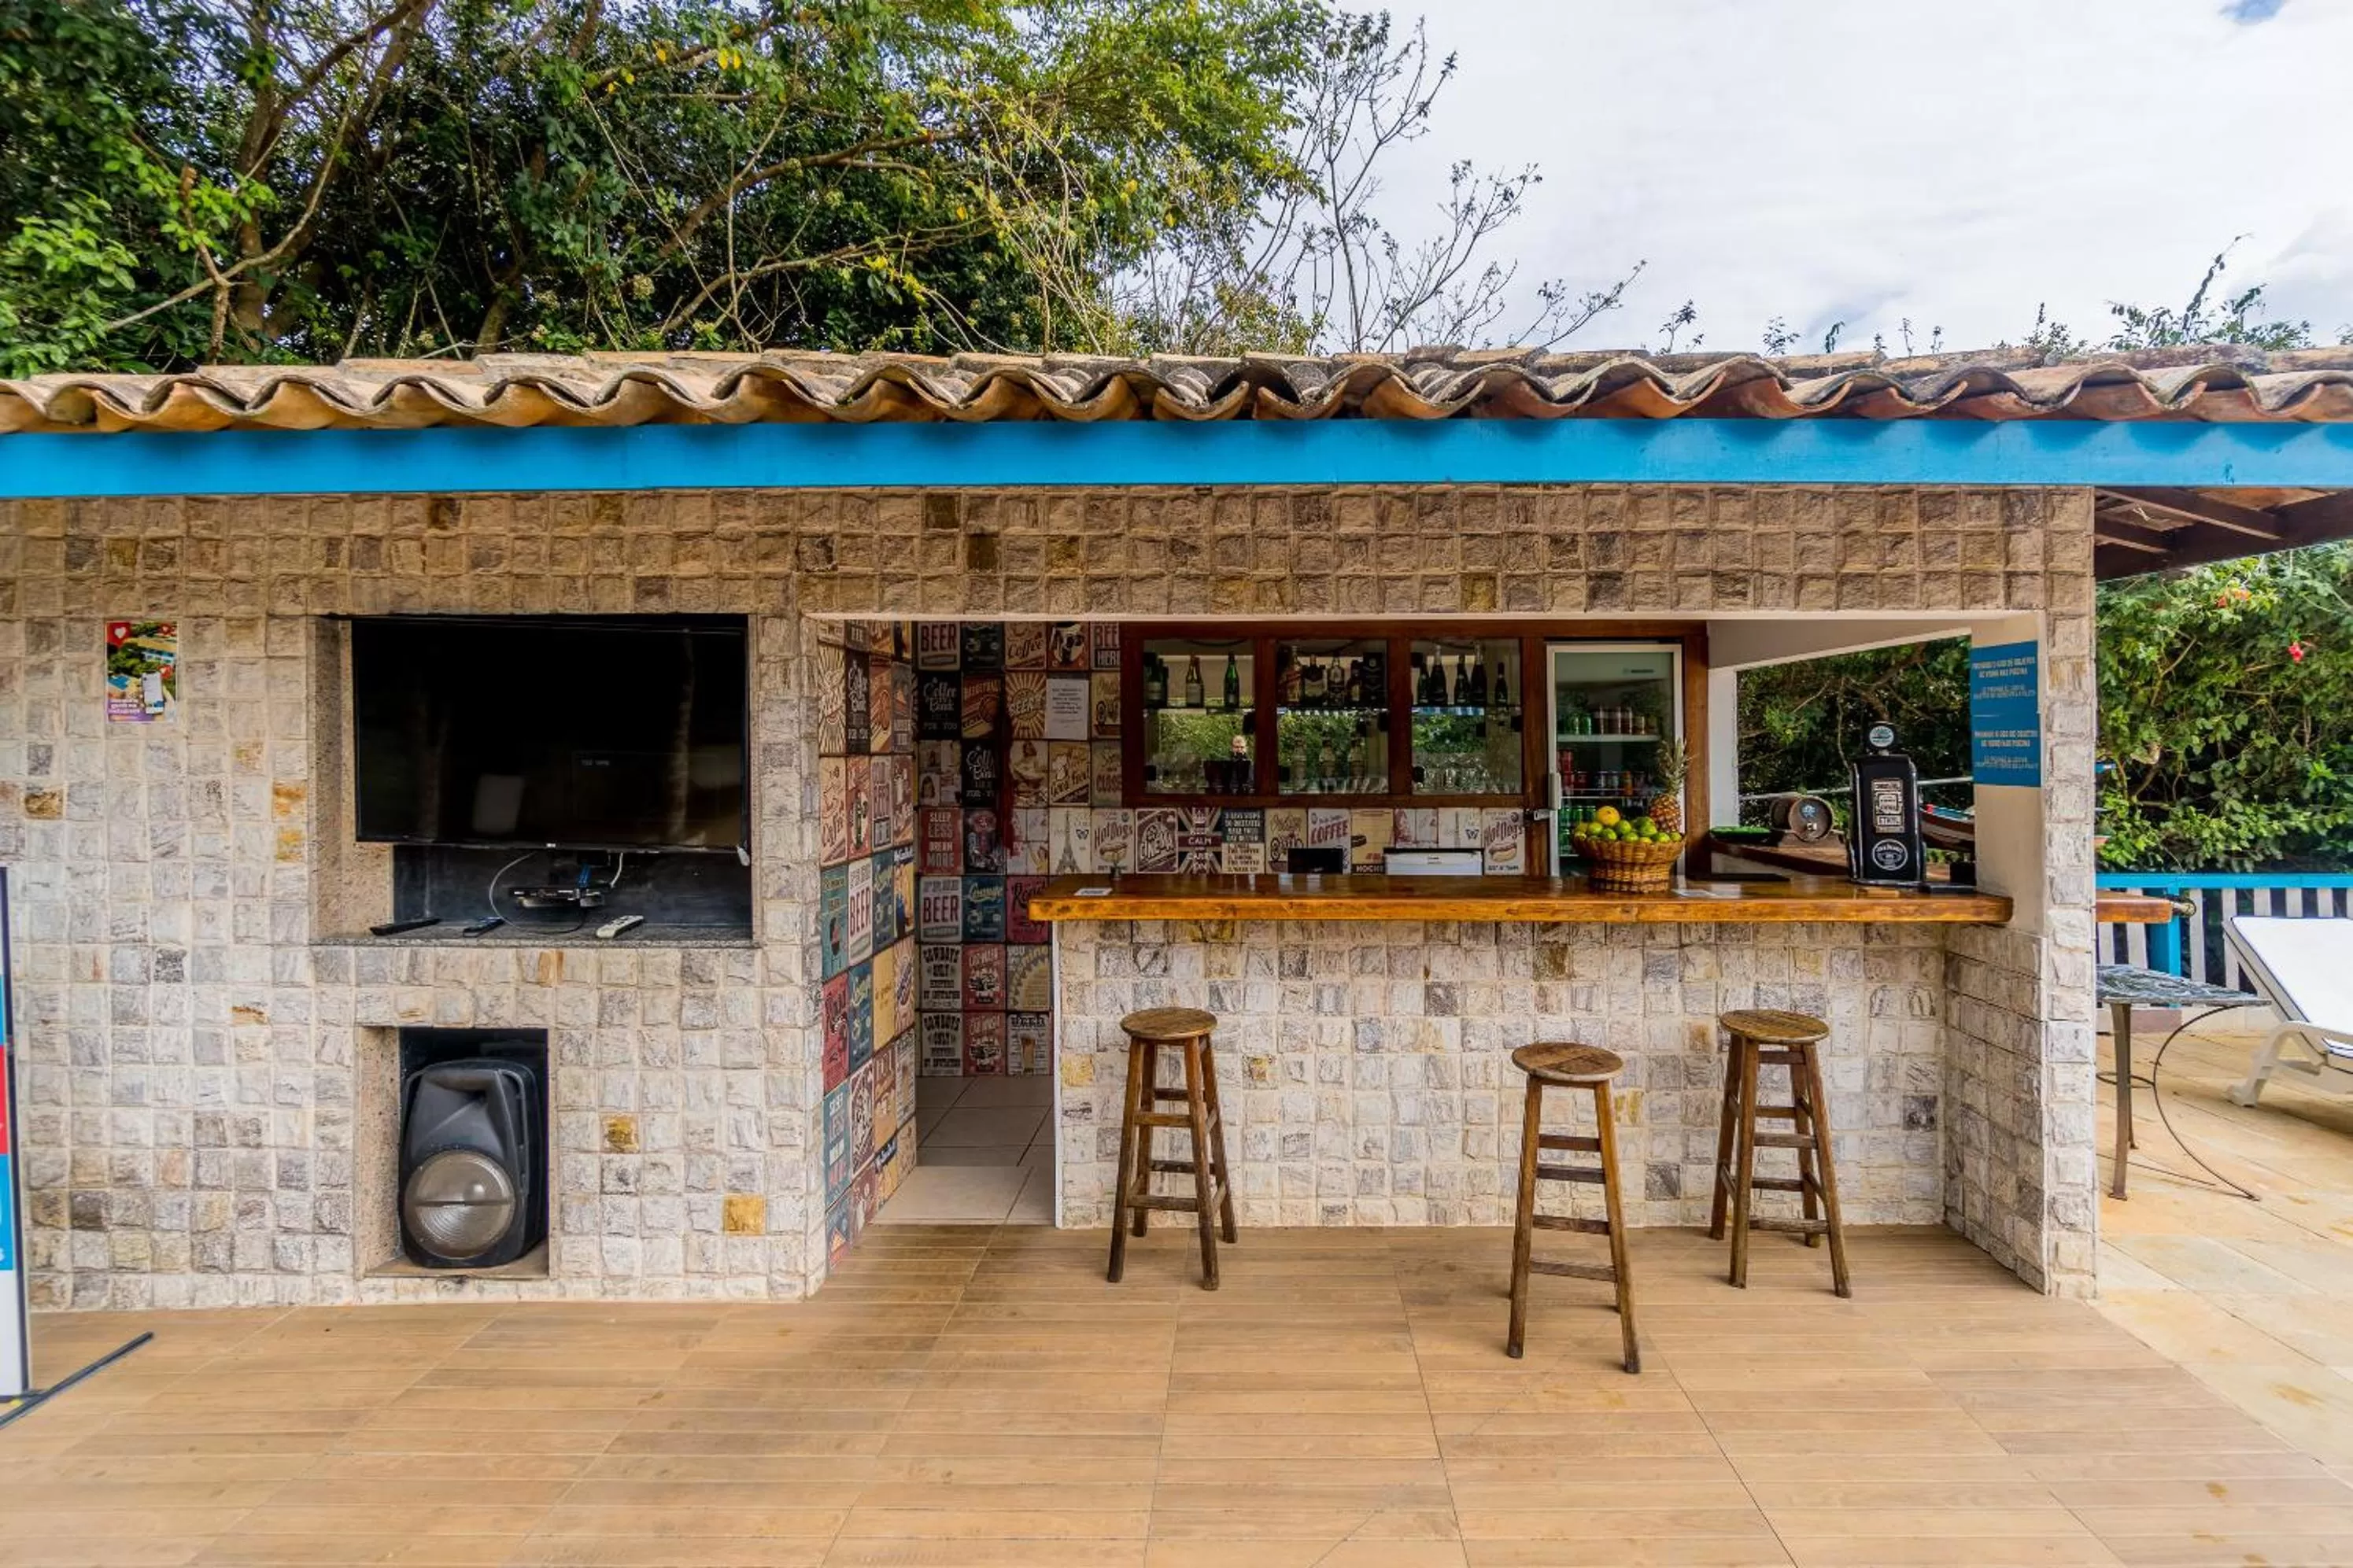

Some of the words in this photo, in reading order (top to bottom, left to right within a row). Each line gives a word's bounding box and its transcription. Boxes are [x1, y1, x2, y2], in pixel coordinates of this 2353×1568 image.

[921, 624, 956, 651] BEER
[1095, 625, 1118, 647] BEE
[1008, 638, 1044, 659] Coffee
[929, 825, 953, 838] LESS
[1311, 821, 1347, 844] COFFEE
[1501, 821, 1523, 840] Dogs
[929, 842, 953, 851] DREAM
[927, 853, 955, 867] MORE
[850, 887, 870, 935] BEER
[924, 895, 959, 922] BEER
[923, 946, 959, 963] COWBOYS
[924, 1015, 960, 1031] COWBOYS
